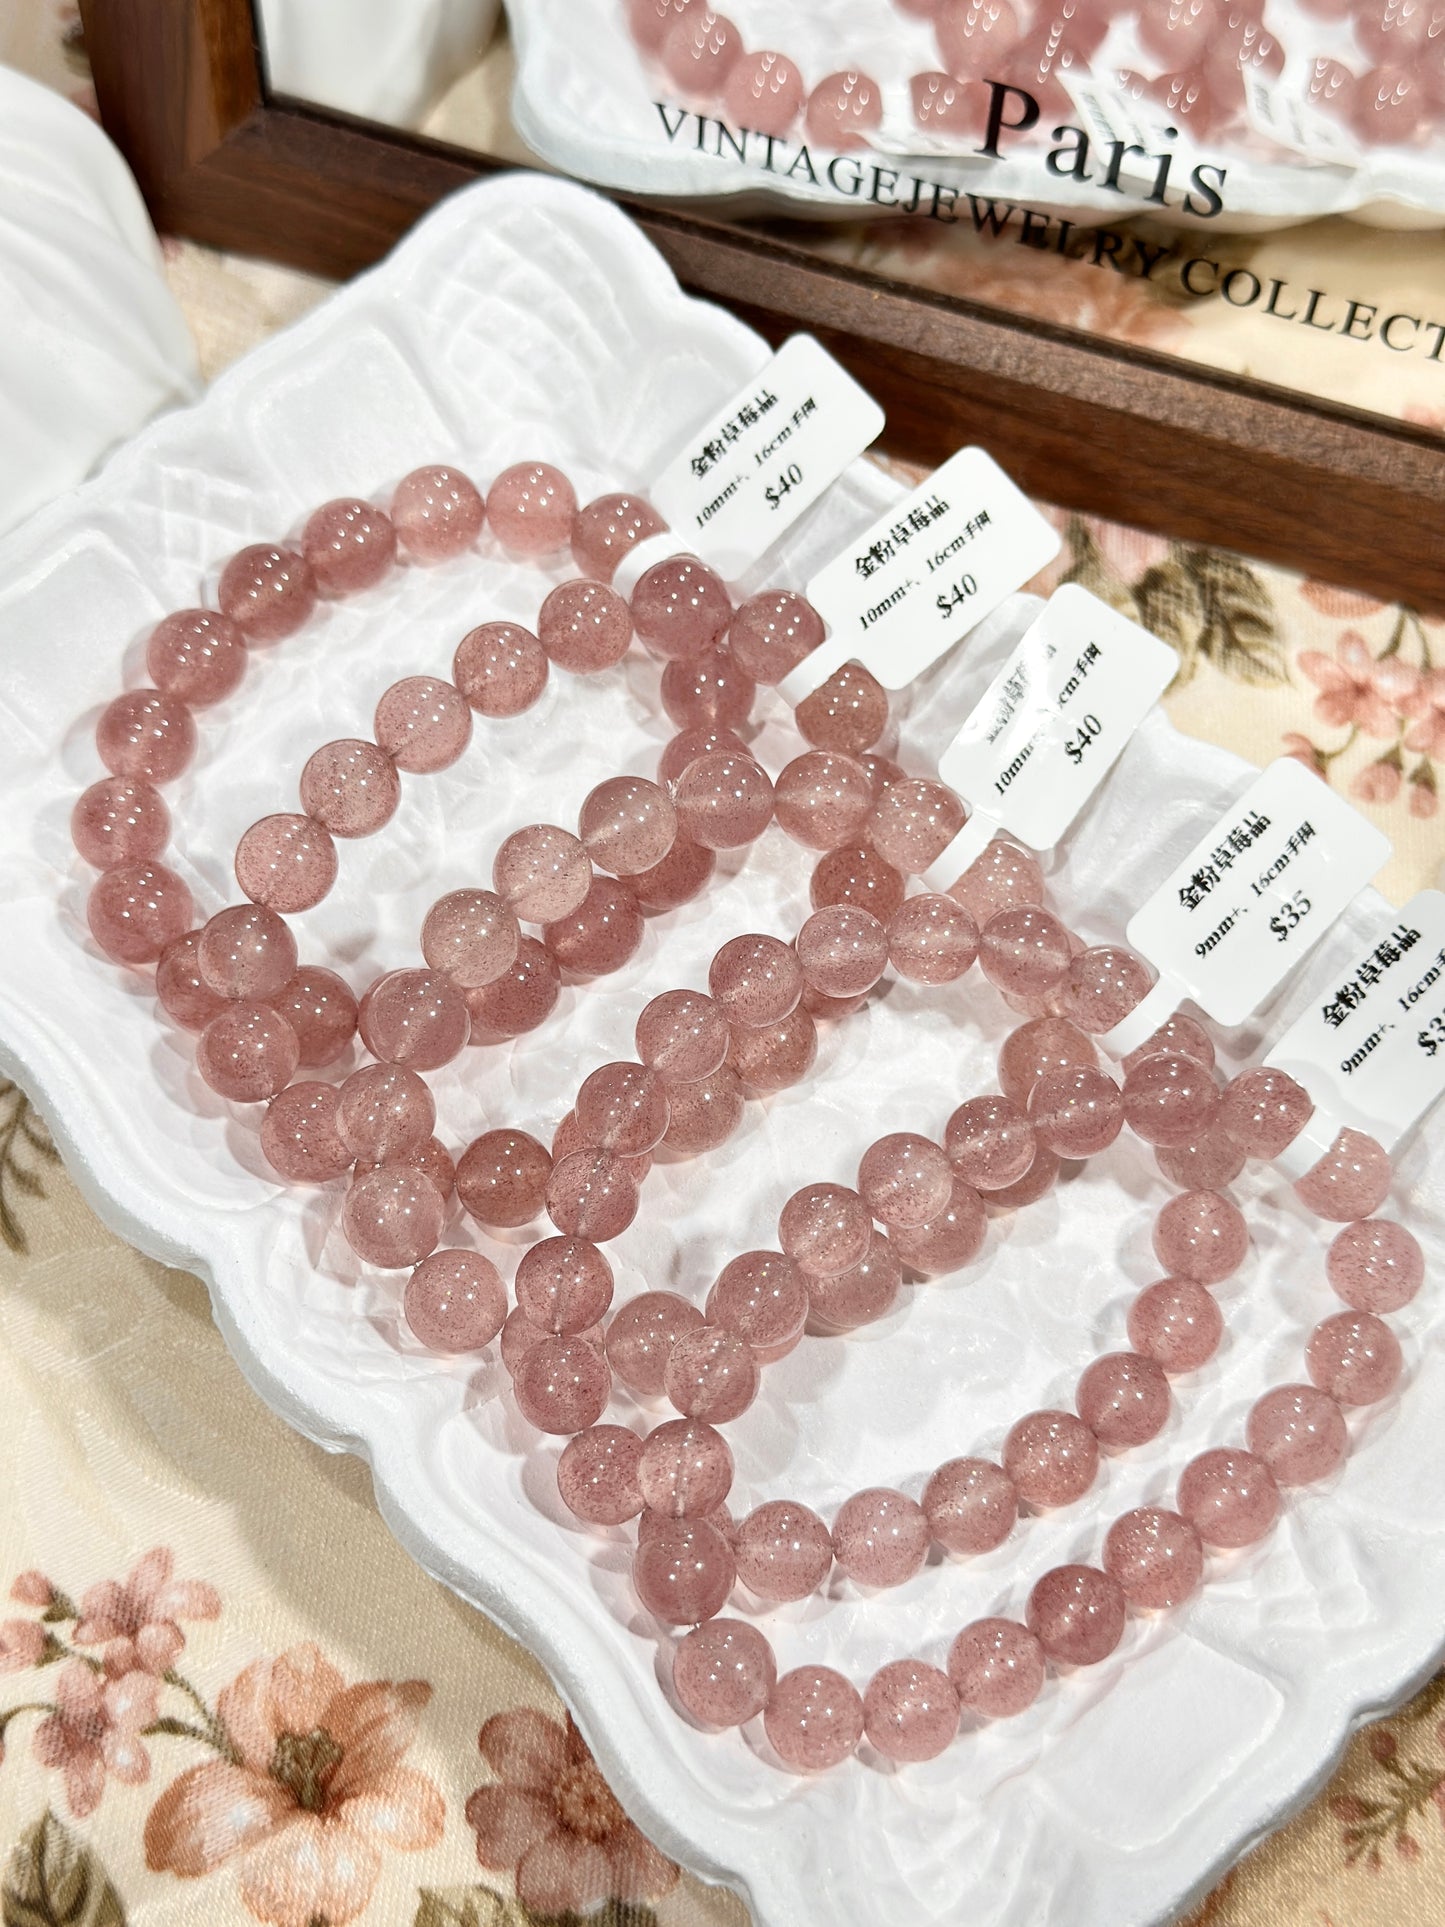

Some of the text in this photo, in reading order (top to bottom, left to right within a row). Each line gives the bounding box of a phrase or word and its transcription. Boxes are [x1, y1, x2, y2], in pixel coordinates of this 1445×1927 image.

[974, 78, 1227, 219] Paris
[1180, 257, 1445, 362] COLLECT
[764, 463, 804, 511] $40
[936, 574, 978, 619] $40
[1064, 714, 1103, 766] $40
[1269, 890, 1312, 943] $35
[1322, 924, 1422, 1029] 金粉草莓晶
[1417, 1006, 1445, 1057] $3
